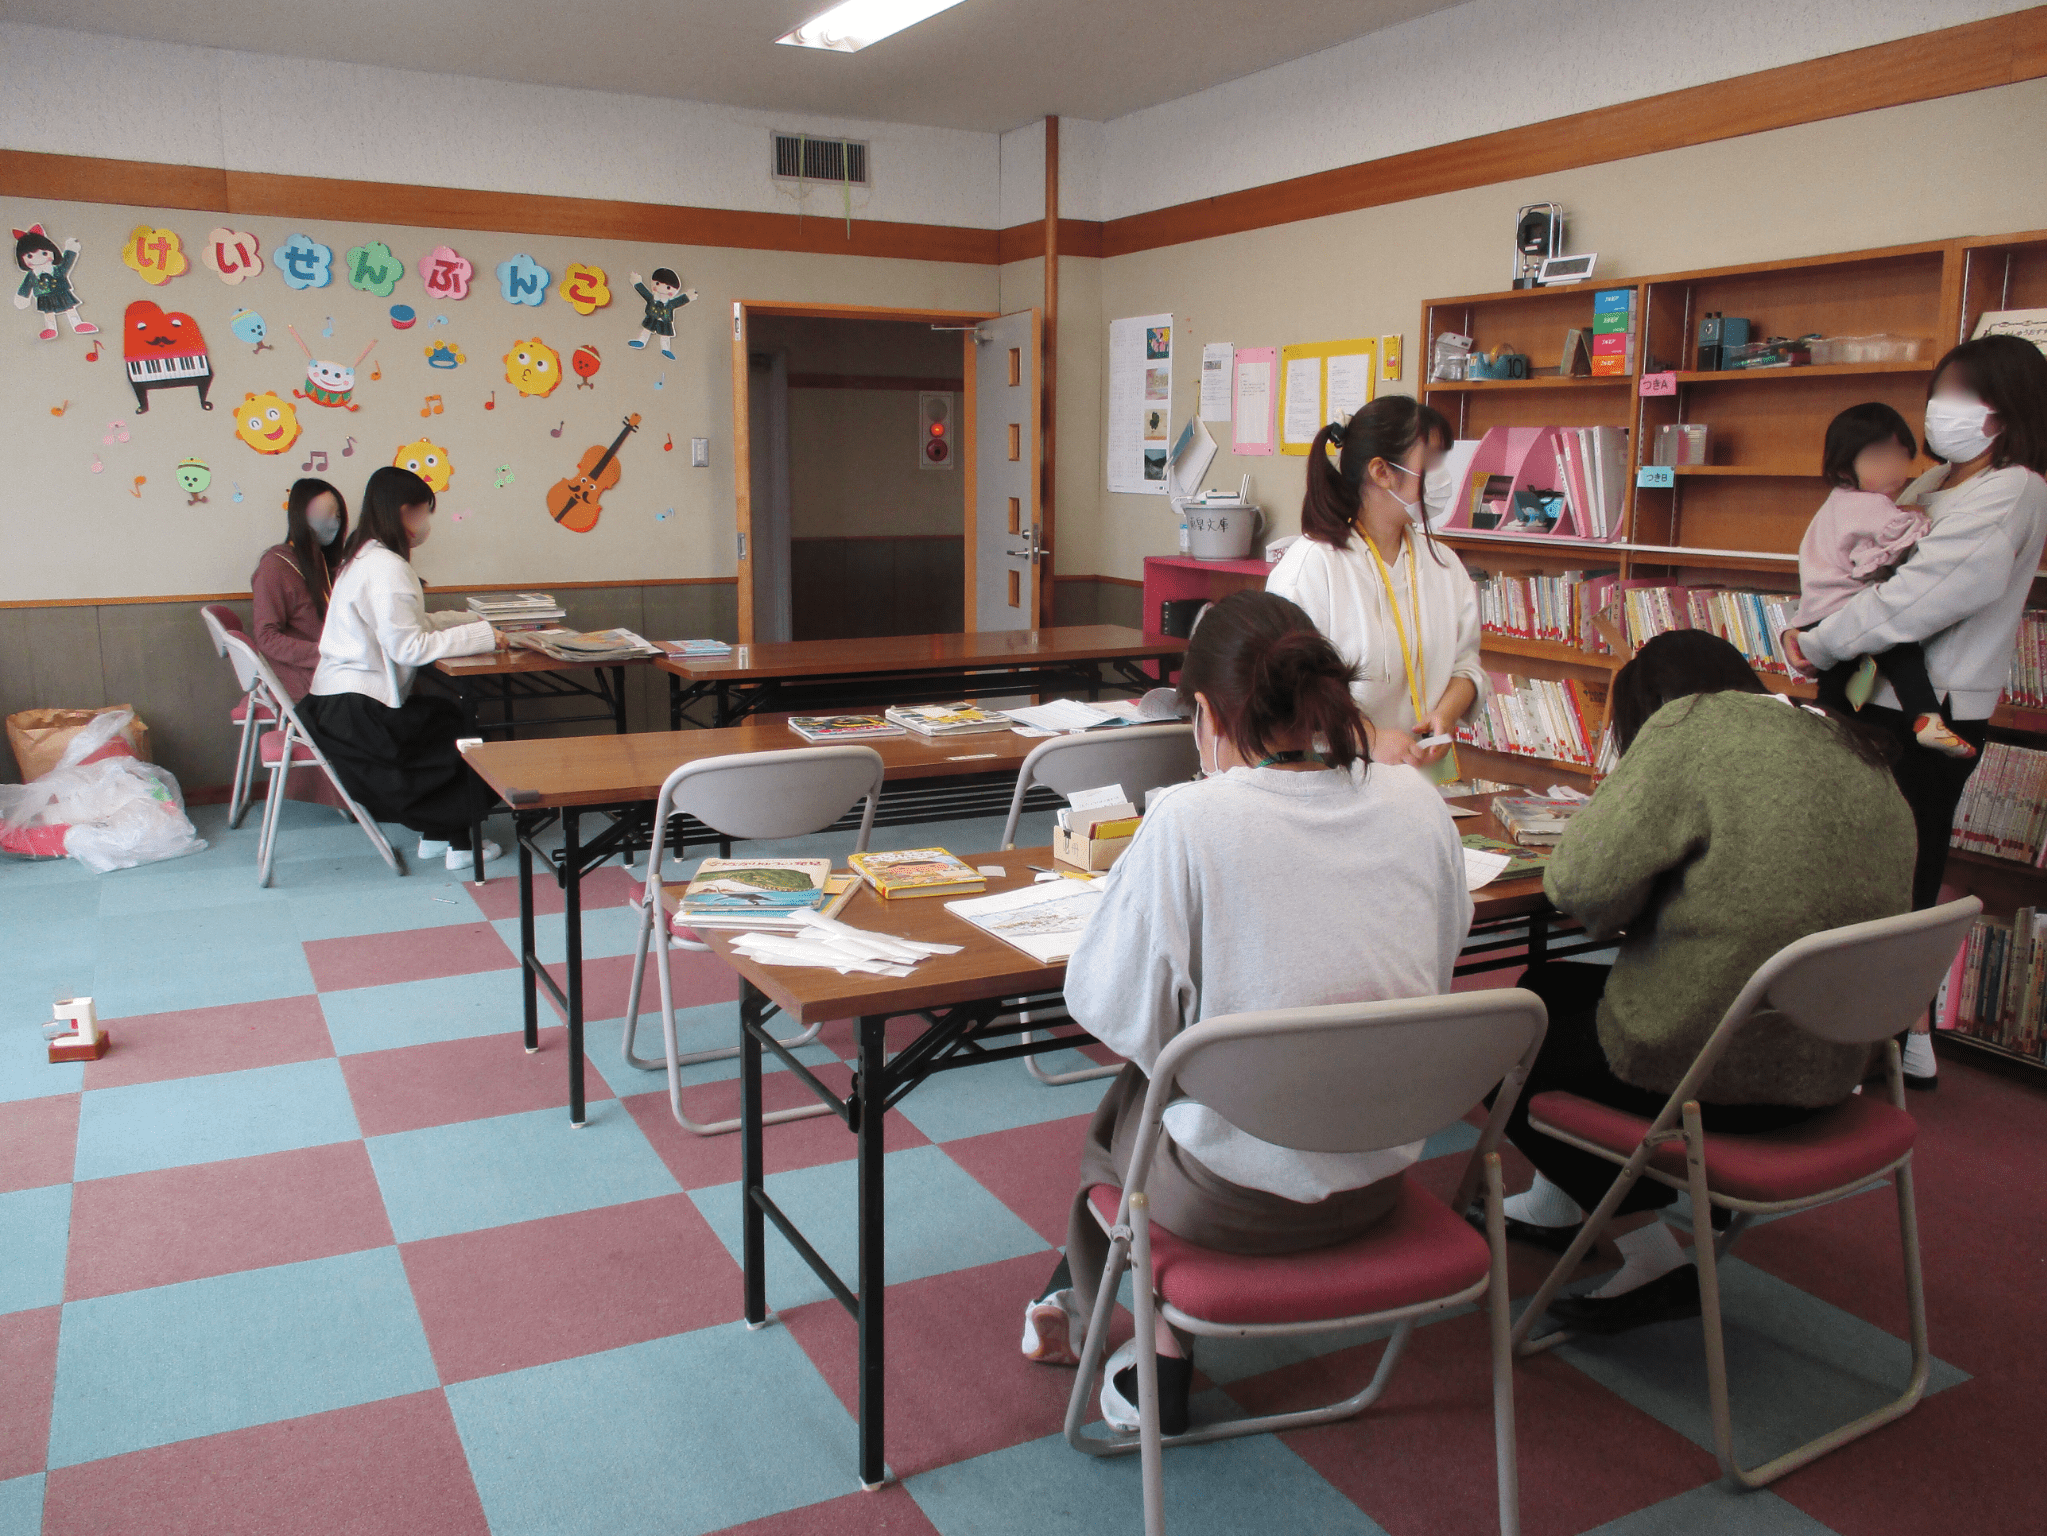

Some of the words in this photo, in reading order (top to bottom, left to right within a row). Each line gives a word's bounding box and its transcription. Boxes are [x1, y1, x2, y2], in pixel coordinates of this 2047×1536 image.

[135, 236, 603, 304] けいせんぶんこ
[1507, 357, 1523, 379] 10
[1643, 379, 1668, 390] つきA
[1646, 472, 1668, 483] つきB
